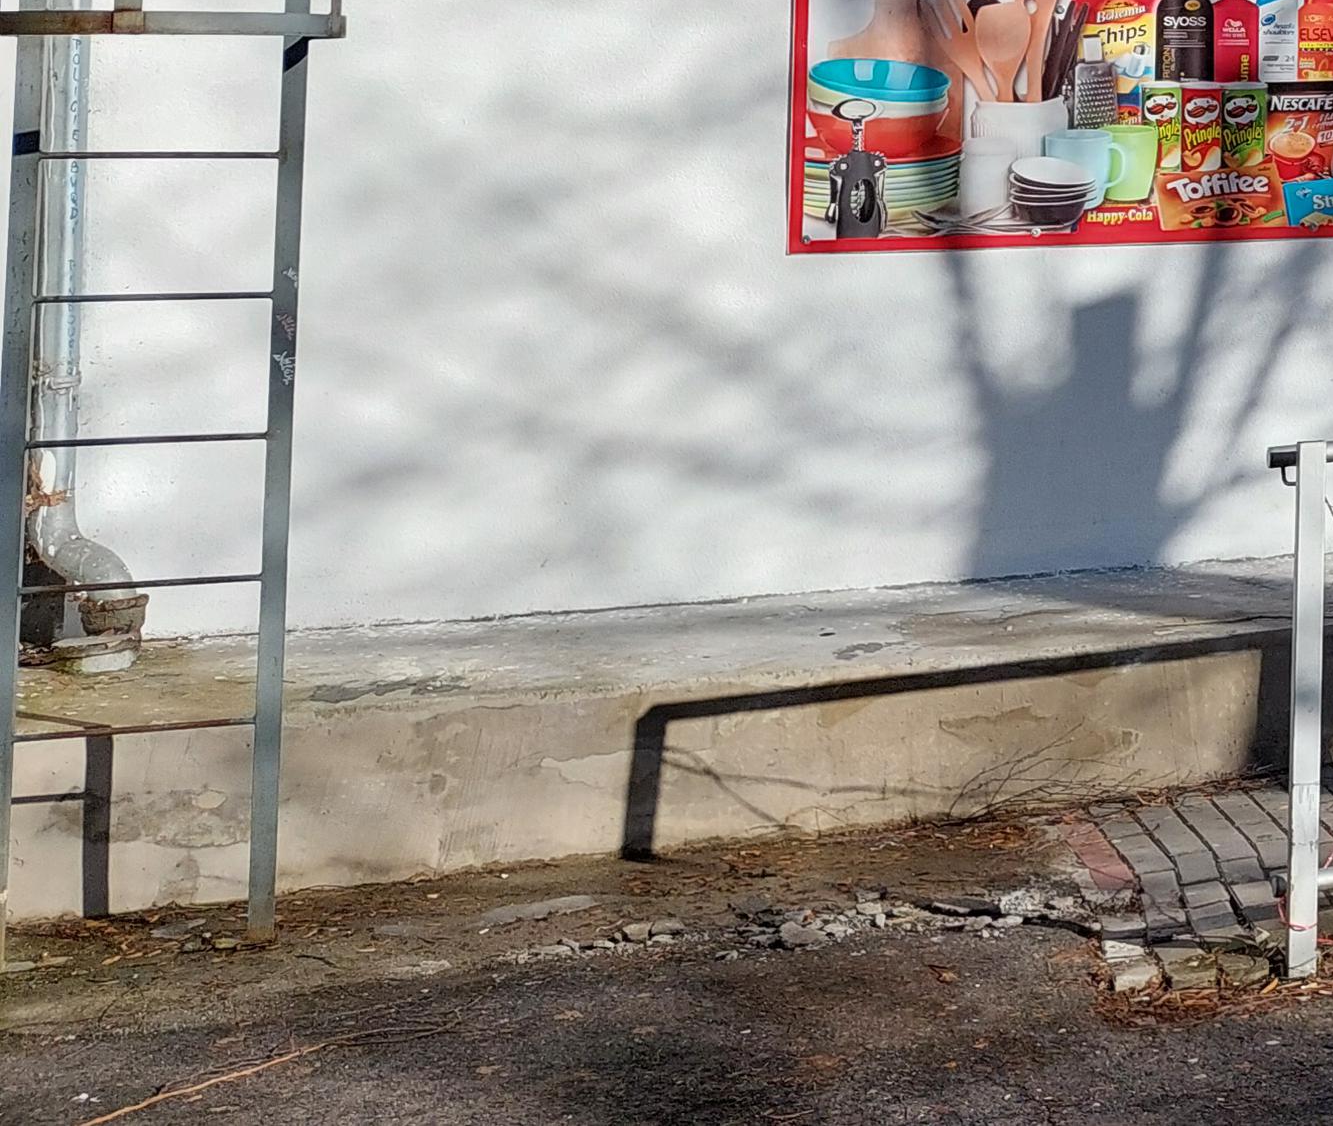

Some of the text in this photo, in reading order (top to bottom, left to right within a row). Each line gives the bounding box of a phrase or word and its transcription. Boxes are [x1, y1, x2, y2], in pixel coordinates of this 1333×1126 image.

[1096, 4, 1147, 23] Bohemia
[1184, 121, 1220, 150] Pringle
[1166, 174, 1269, 203] Toffifee
[1086, 208, 1153, 225] Happy-Cola
